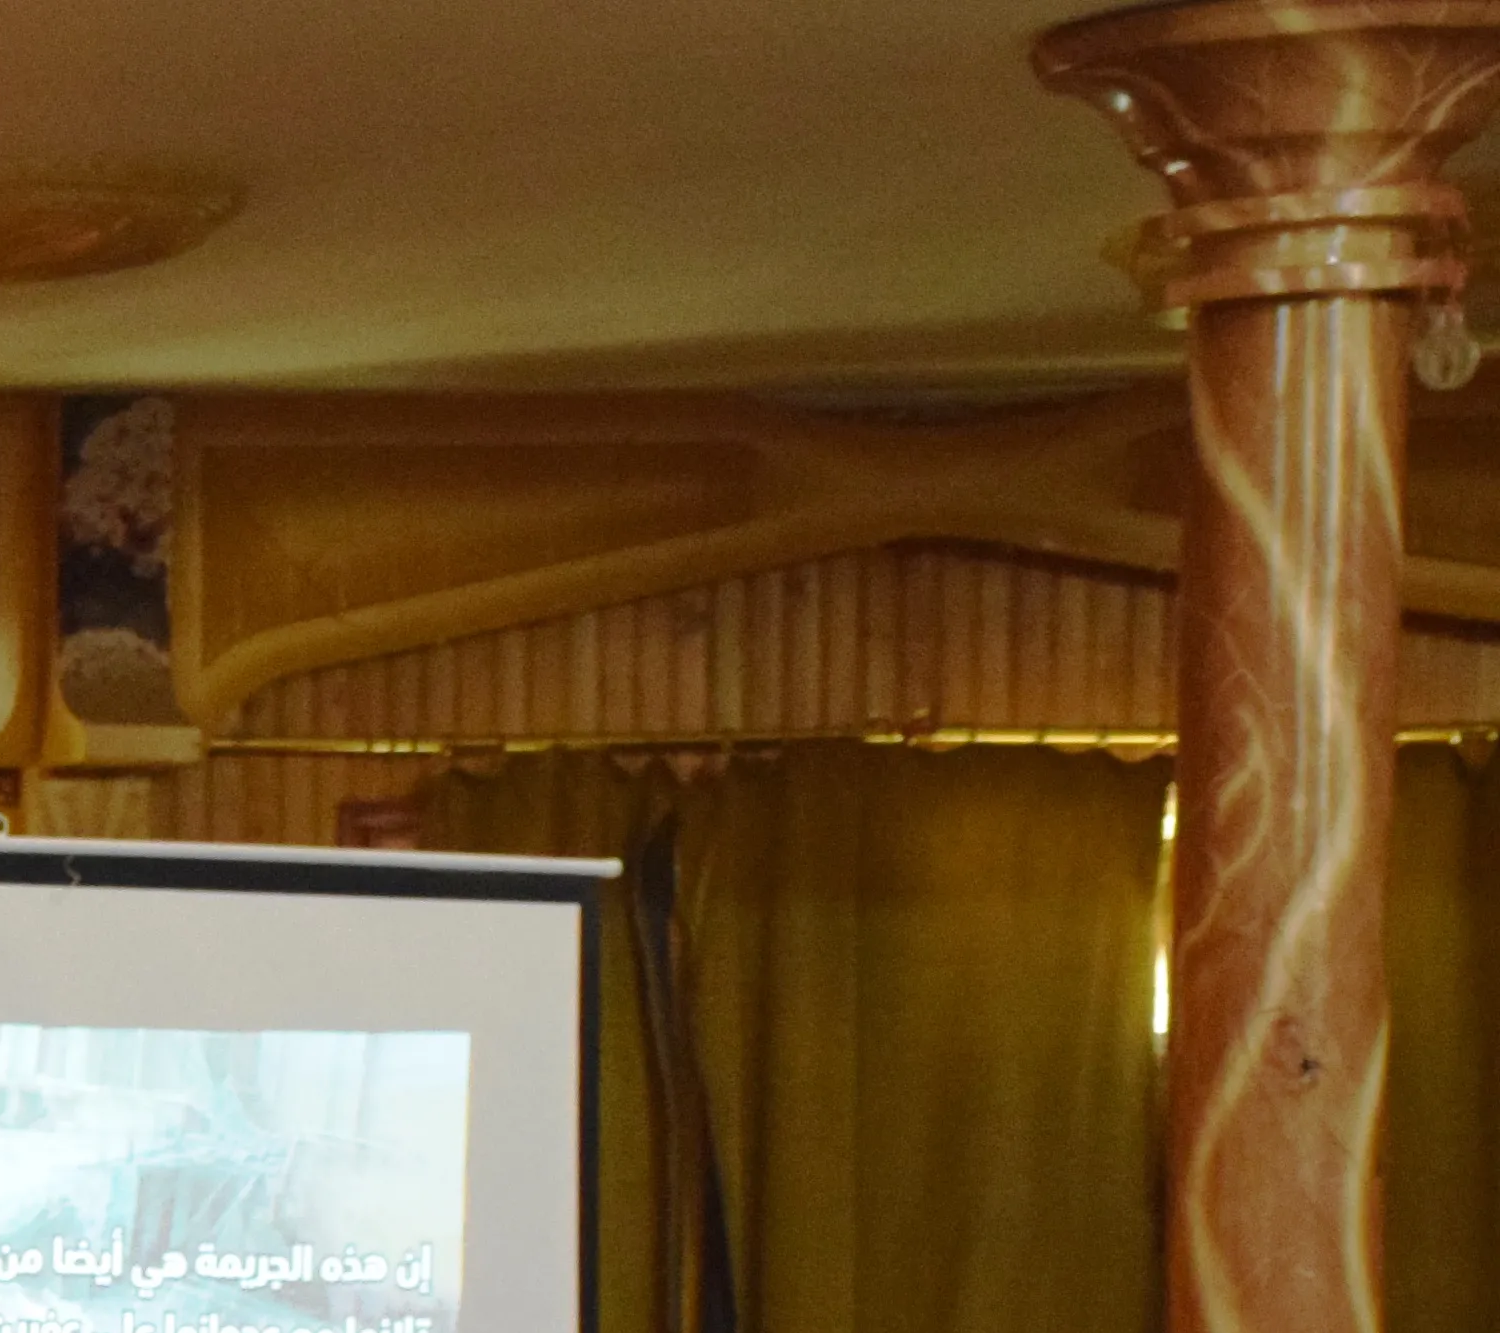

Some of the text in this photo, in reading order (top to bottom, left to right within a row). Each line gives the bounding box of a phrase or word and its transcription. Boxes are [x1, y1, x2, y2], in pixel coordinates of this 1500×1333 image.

[130, 1248, 187, 1296] هي
[195, 1242, 312, 1290] الجريمة
[321, 1243, 387, 1283] هذه
[396, 1242, 432, 1290] إن
